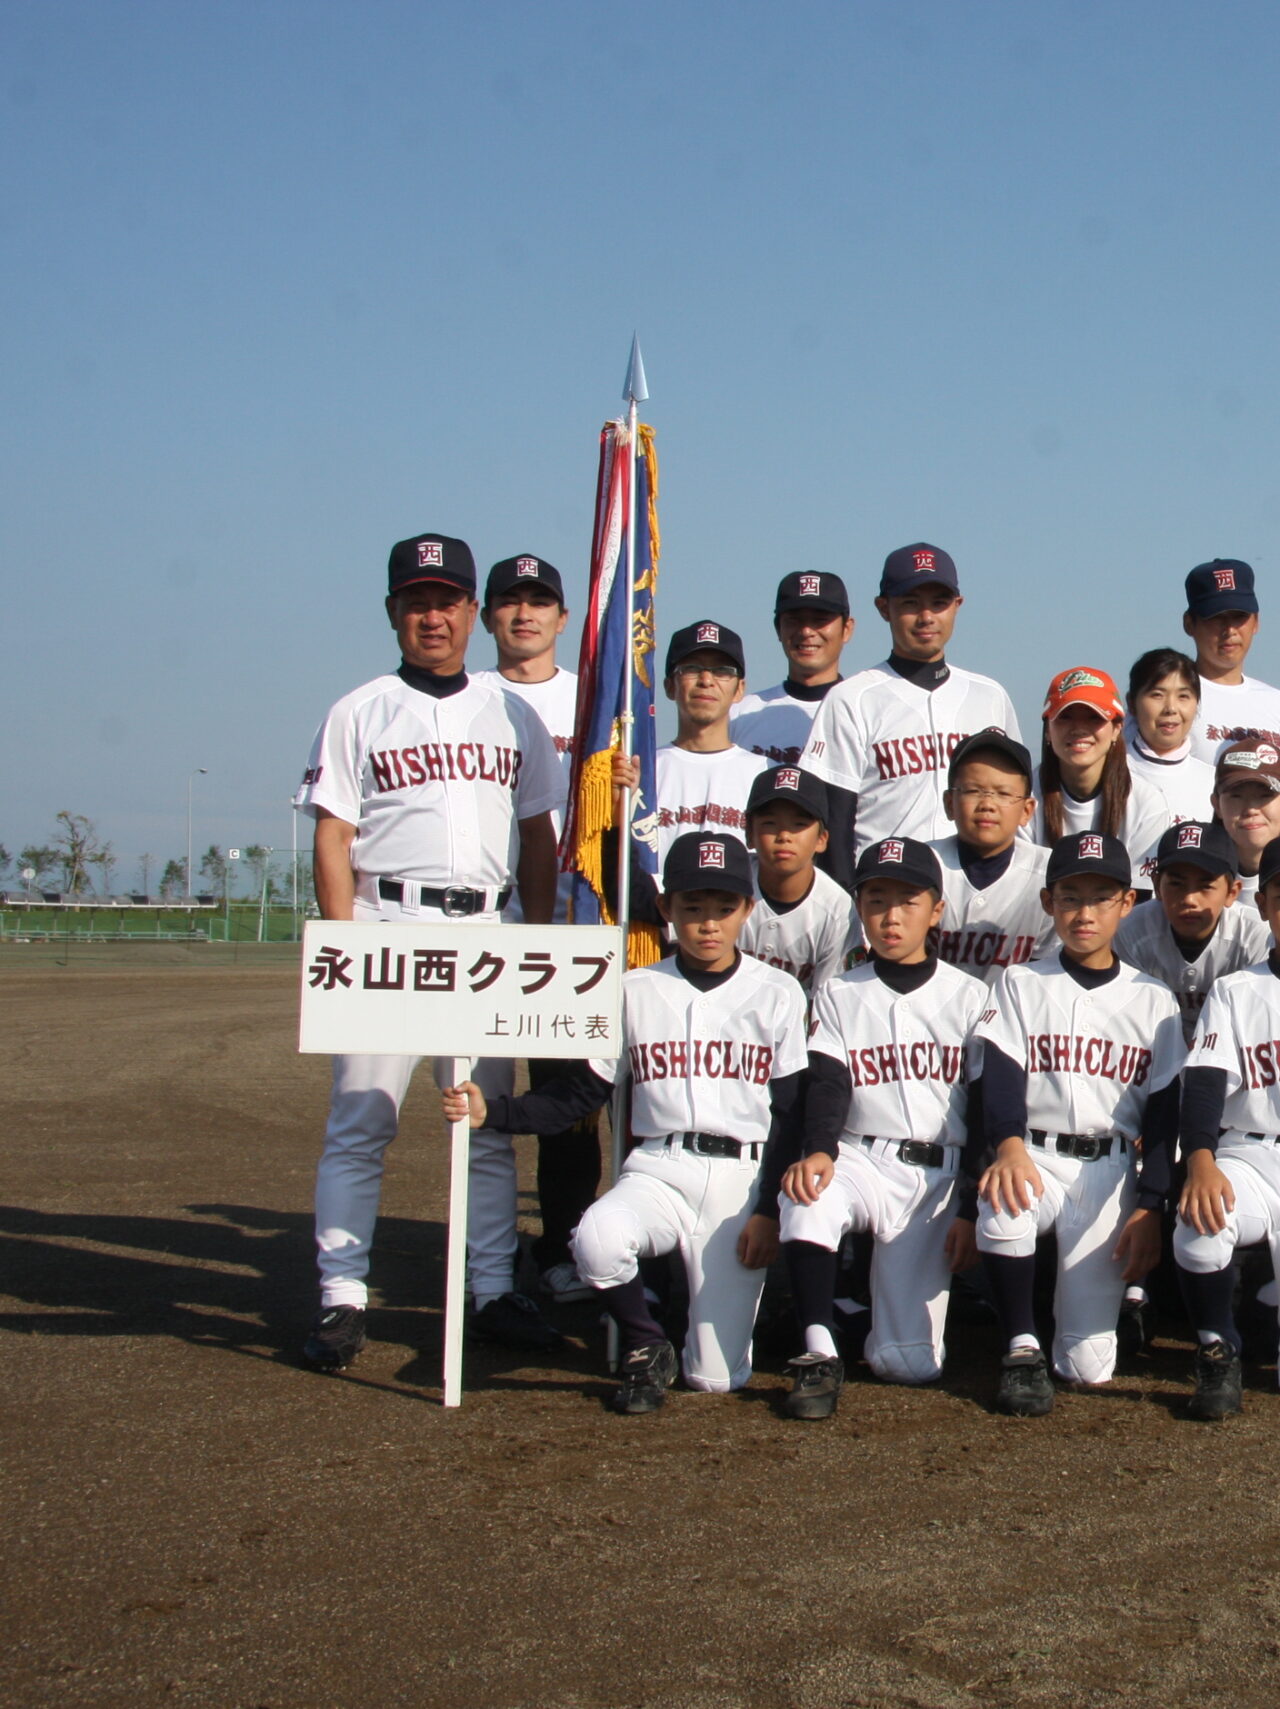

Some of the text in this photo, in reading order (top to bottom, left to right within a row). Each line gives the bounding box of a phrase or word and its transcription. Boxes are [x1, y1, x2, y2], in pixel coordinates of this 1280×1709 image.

[369, 742, 523, 793] NISHICLUB
[872, 731, 970, 781] NISHIC
[308, 945, 616, 994] 永山西クラブ
[485, 1013, 611, 1040] 上川代表
[629, 1039, 773, 1086] NISHICLUB
